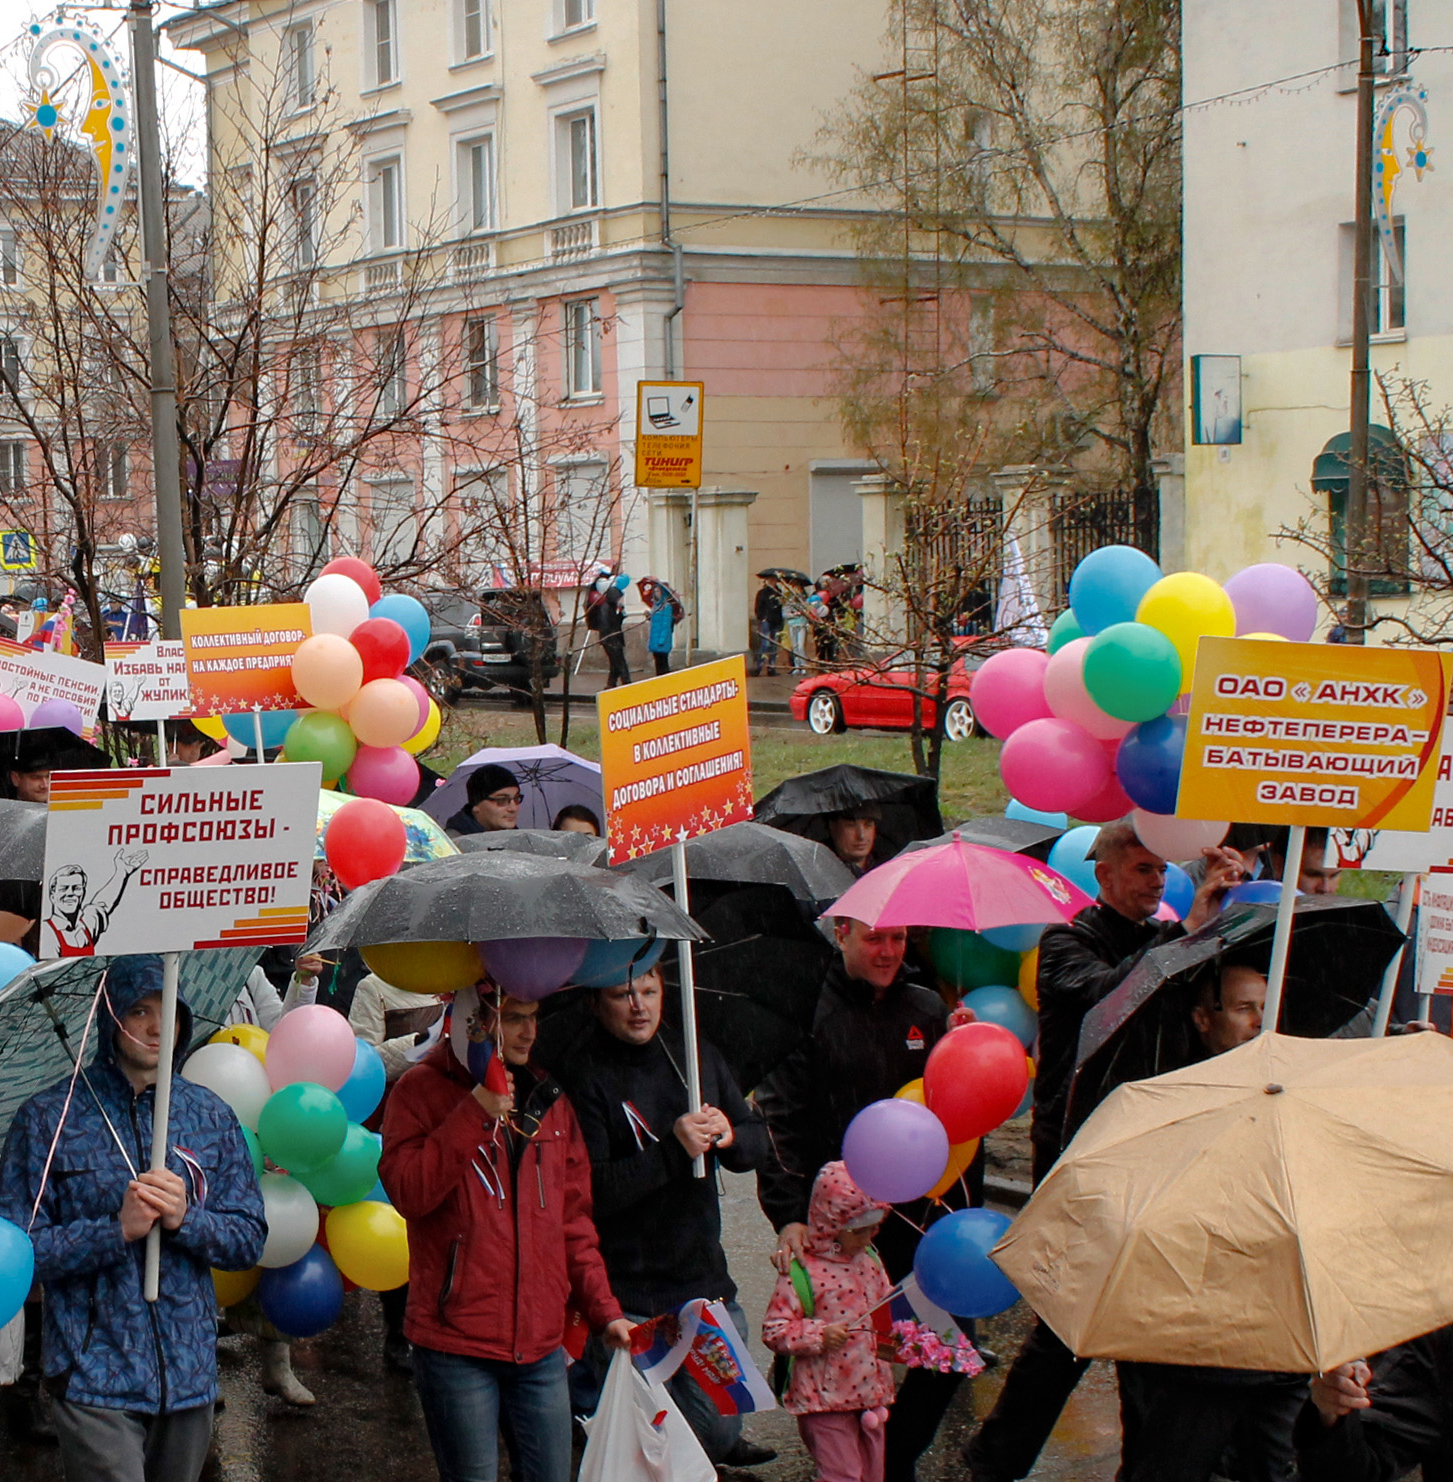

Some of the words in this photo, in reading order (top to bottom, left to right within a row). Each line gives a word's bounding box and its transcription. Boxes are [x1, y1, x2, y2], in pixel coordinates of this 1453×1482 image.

[190, 629, 262, 649] КОЛЛЕКТИВНЫЙ
[192, 660, 205, 674] НА
[207, 656, 245, 672] КАЖДОЕ
[57, 676, 101, 697] ПЕНСИИ,
[158, 677, 171, 687] ОТ
[1216, 676, 1285, 698] ОАО
[26, 692, 40, 703] ПО
[29, 681, 36, 690] А
[38, 683, 51, 694] НЕ
[52, 688, 97, 707] ПОСОБИЯ
[141, 689, 190, 701] ЖУЛИК
[608, 695, 679, 732] СОЦИАЛЬНЫЕ
[633, 744, 642, 763] В
[642, 719, 721, 761] КОЛЛЕКТИВНЫЕ
[1206, 748, 1418, 778] БАТЫВАЮЩИЙ
[612, 775, 666, 811] ДОГОВОРА
[666, 771, 675, 791] И
[675, 750, 744, 788] СОГЛАШЕНИЯ!
[140, 790, 264, 815] СИЛЬНЫЕ
[1259, 783, 1356, 806] ЗАВОД
[107, 818, 276, 846] ПРОФСОЮЗЫ
[139, 861, 299, 886] СПРАВЕДЛИВОЕ
[159, 886, 276, 909] ОБЩЕСТВО!
